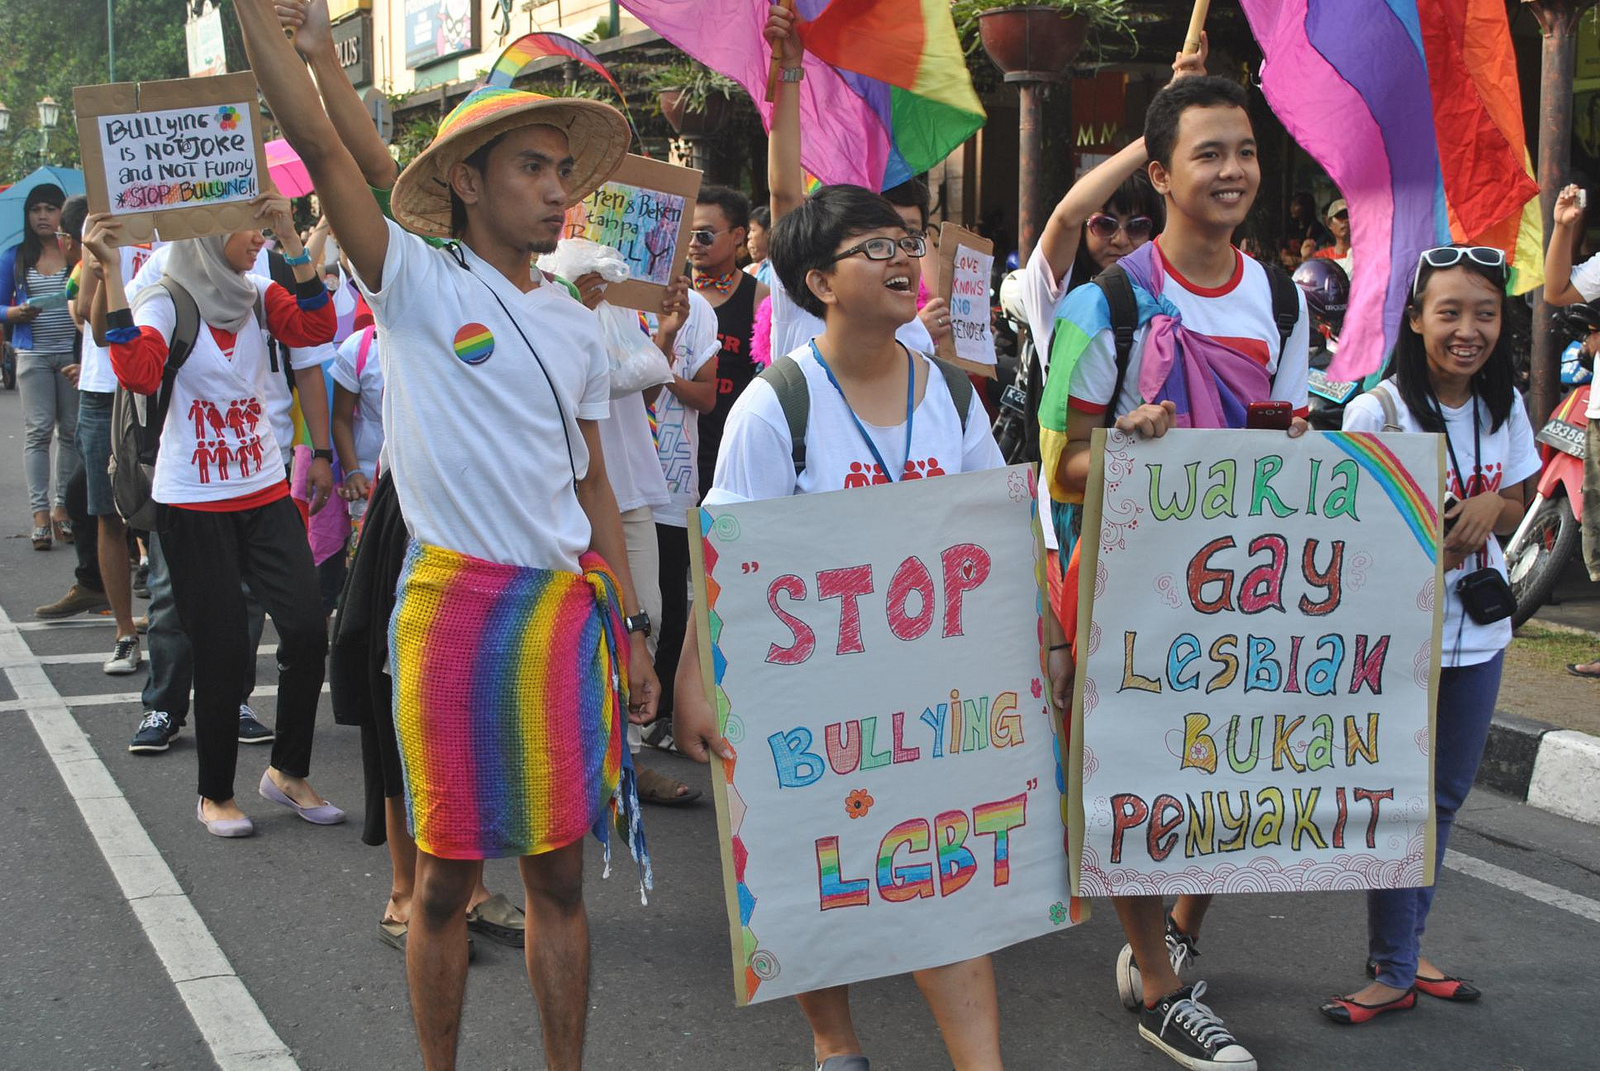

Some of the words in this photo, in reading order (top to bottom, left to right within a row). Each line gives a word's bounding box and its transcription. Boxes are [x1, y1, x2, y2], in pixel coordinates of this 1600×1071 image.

[118, 164, 153, 185] and
[158, 161, 199, 181] NOT
[952, 279, 984, 296] KNOWS
[952, 298, 970, 316] NO
[1186, 532, 1346, 617] Gay
